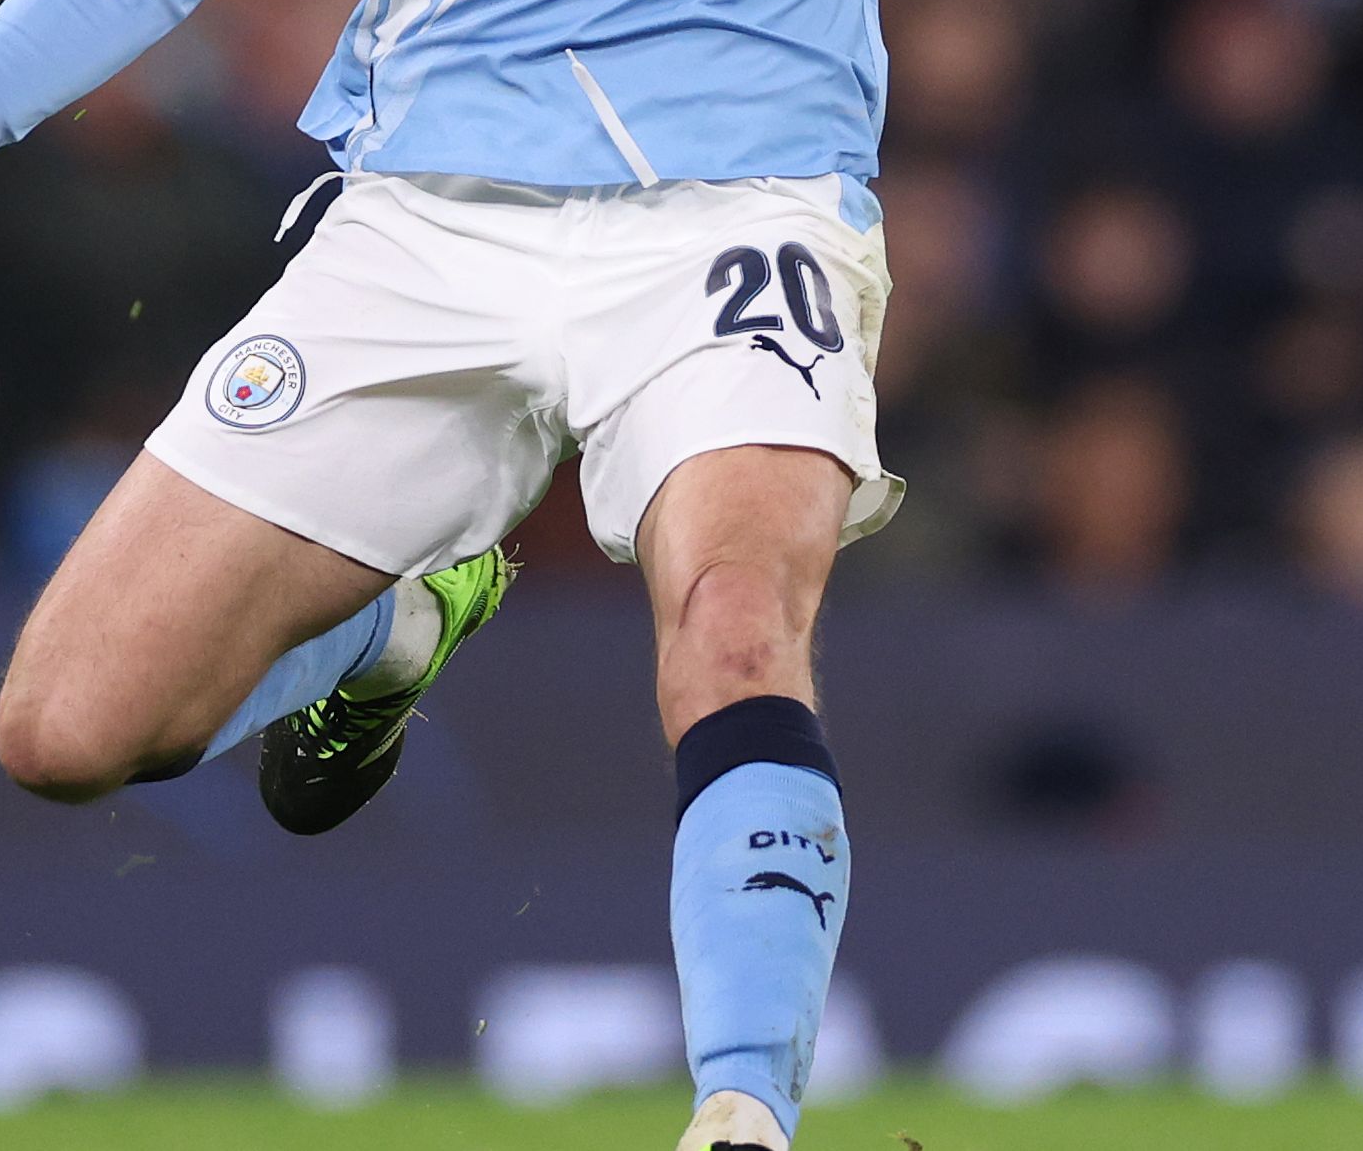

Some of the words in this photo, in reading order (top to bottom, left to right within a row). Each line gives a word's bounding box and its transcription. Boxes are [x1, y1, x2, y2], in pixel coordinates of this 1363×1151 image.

[705, 241, 844, 353] 20
[234, 342, 298, 390] MANCHESTER
[217, 404, 244, 420] CITY
